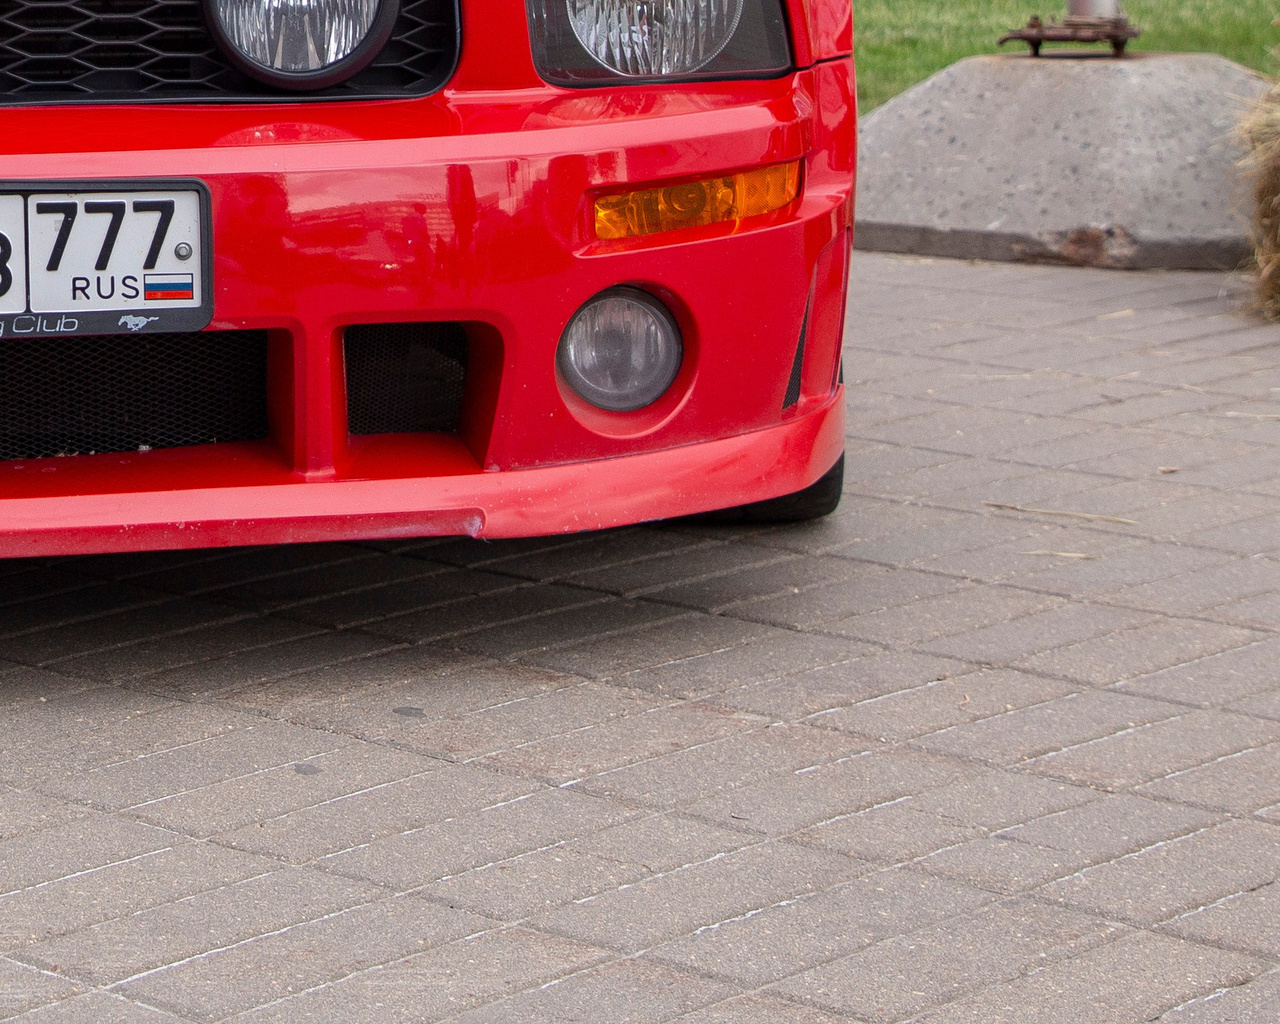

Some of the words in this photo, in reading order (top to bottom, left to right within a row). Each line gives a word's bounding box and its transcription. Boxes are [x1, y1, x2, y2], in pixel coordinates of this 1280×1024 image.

[36, 199, 175, 272] 777
[72, 275, 140, 301] RUS
[11, 314, 78, 334] Club
